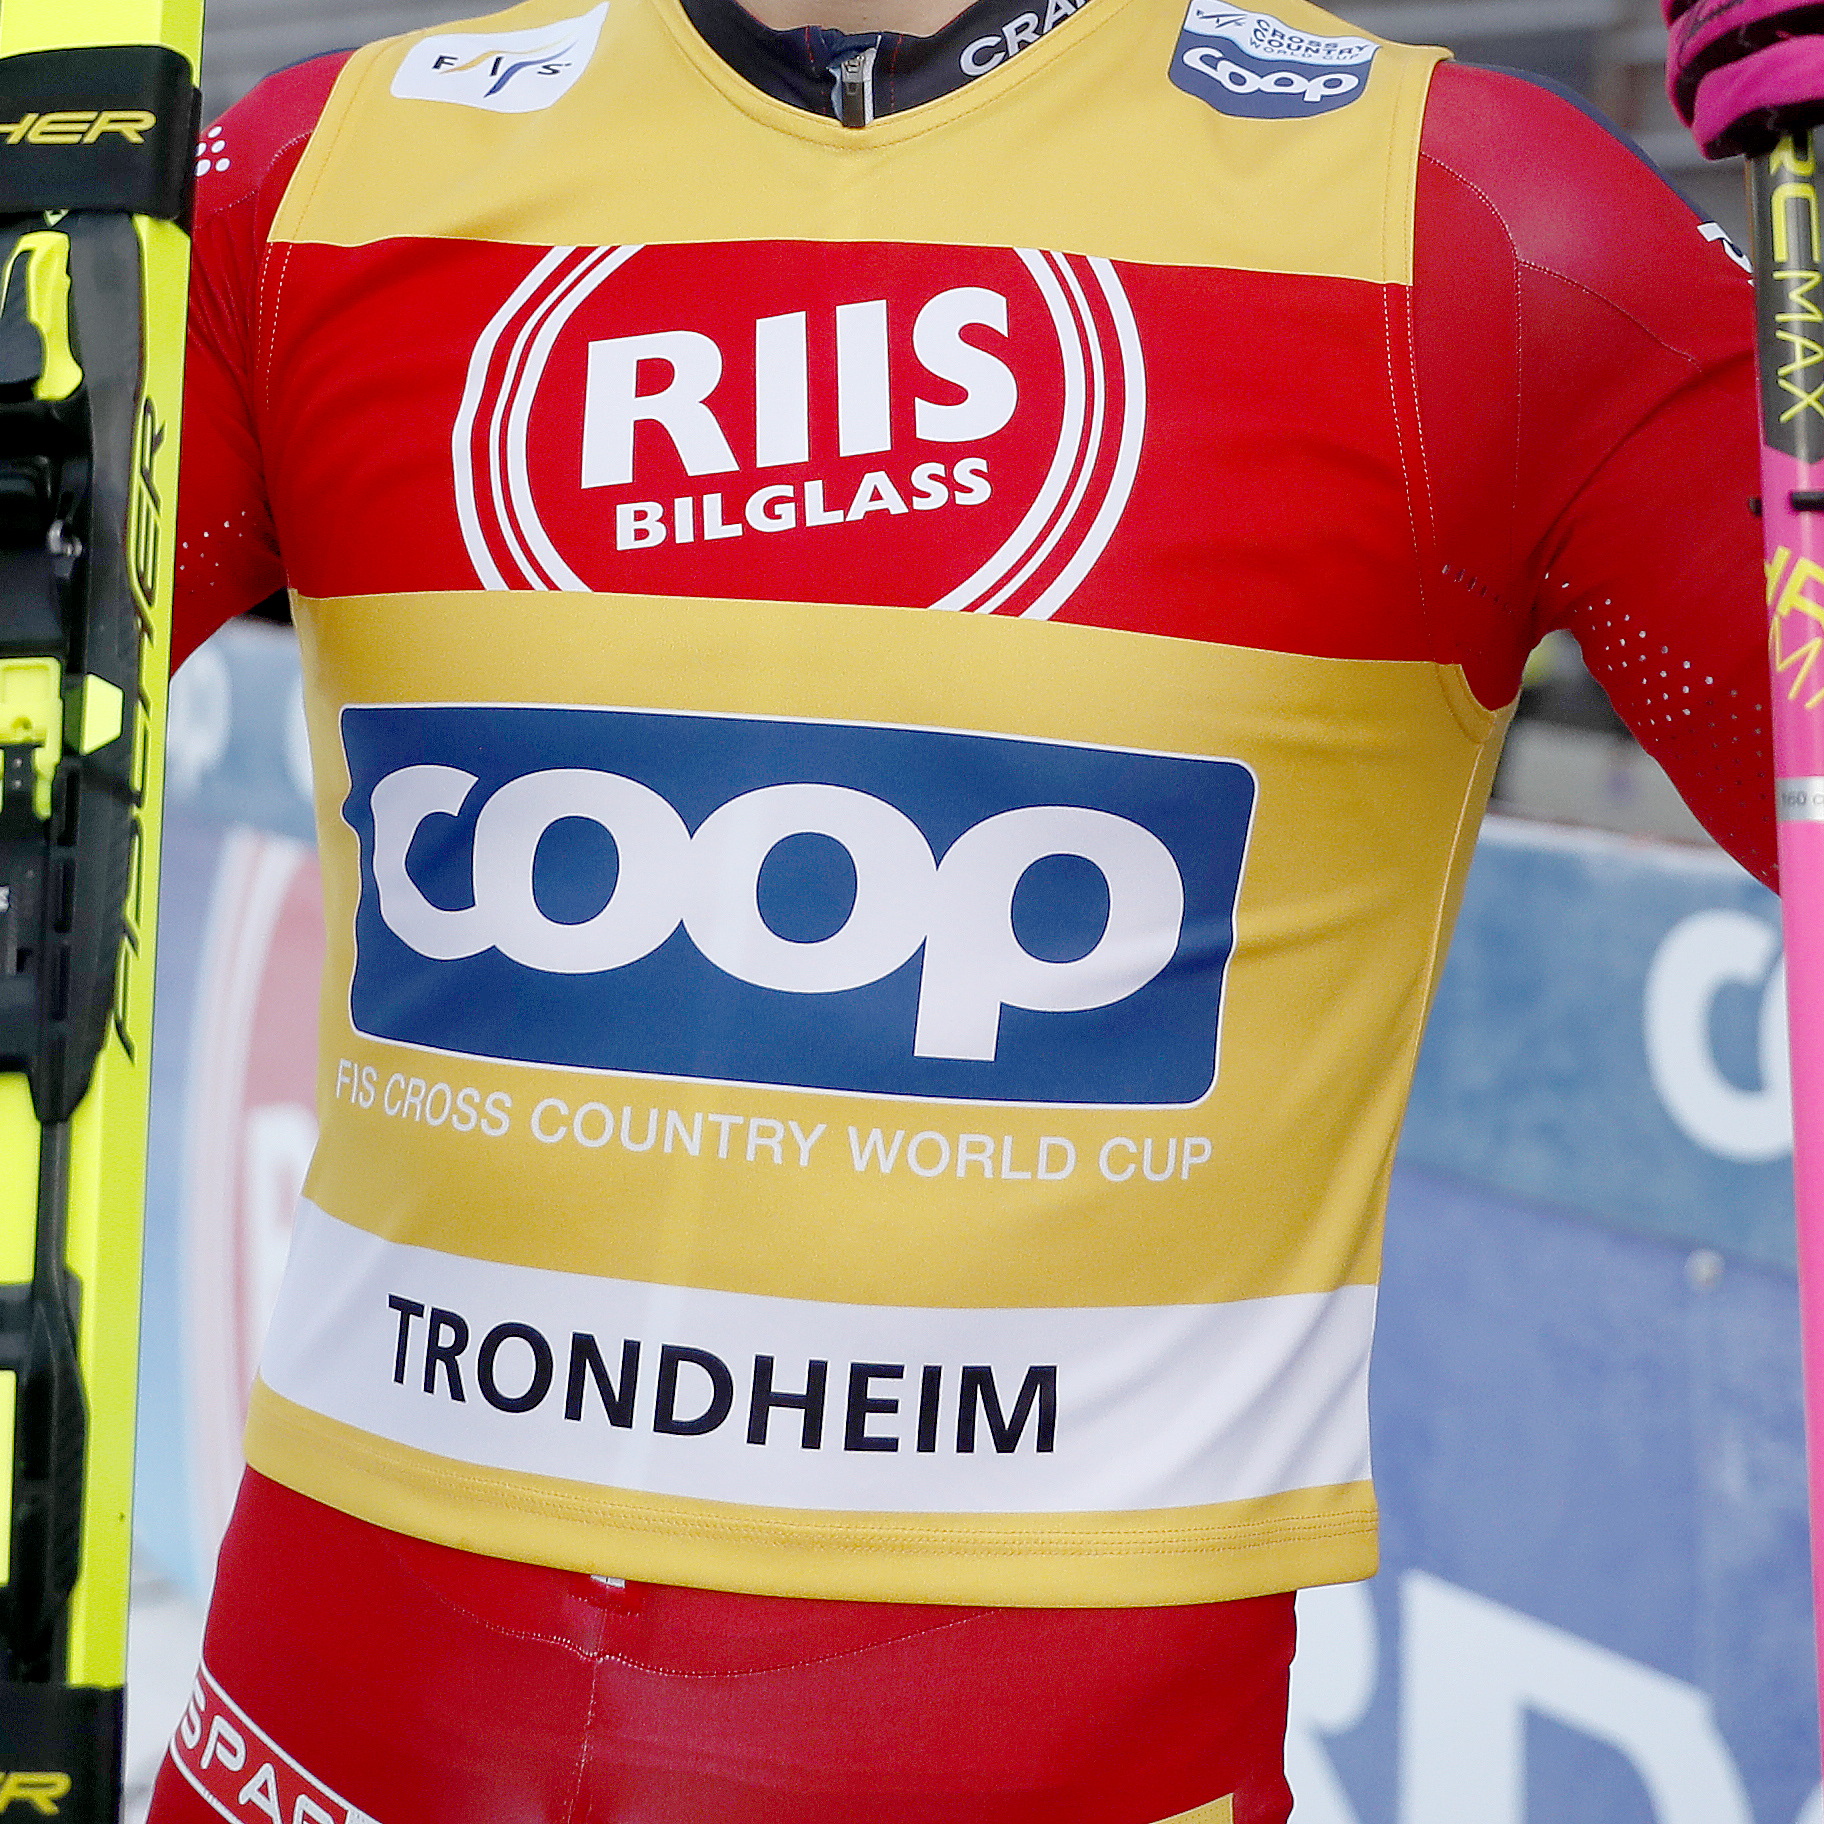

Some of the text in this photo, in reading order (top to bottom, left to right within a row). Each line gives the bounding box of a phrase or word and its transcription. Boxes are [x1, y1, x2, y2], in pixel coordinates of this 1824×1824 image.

[1183, 47, 1358, 102] coop
[1256, 19, 1338, 48] CROSS
[580, 287, 1017, 490] RIIS
[616, 457, 992, 551] BILGLASS
[369, 763, 1184, 1063] coop
[335, 1060, 1213, 1183] FIS CROSS COUNTRY WORLD CUP
[387, 1294, 1058, 1456] TRONDHEIM
